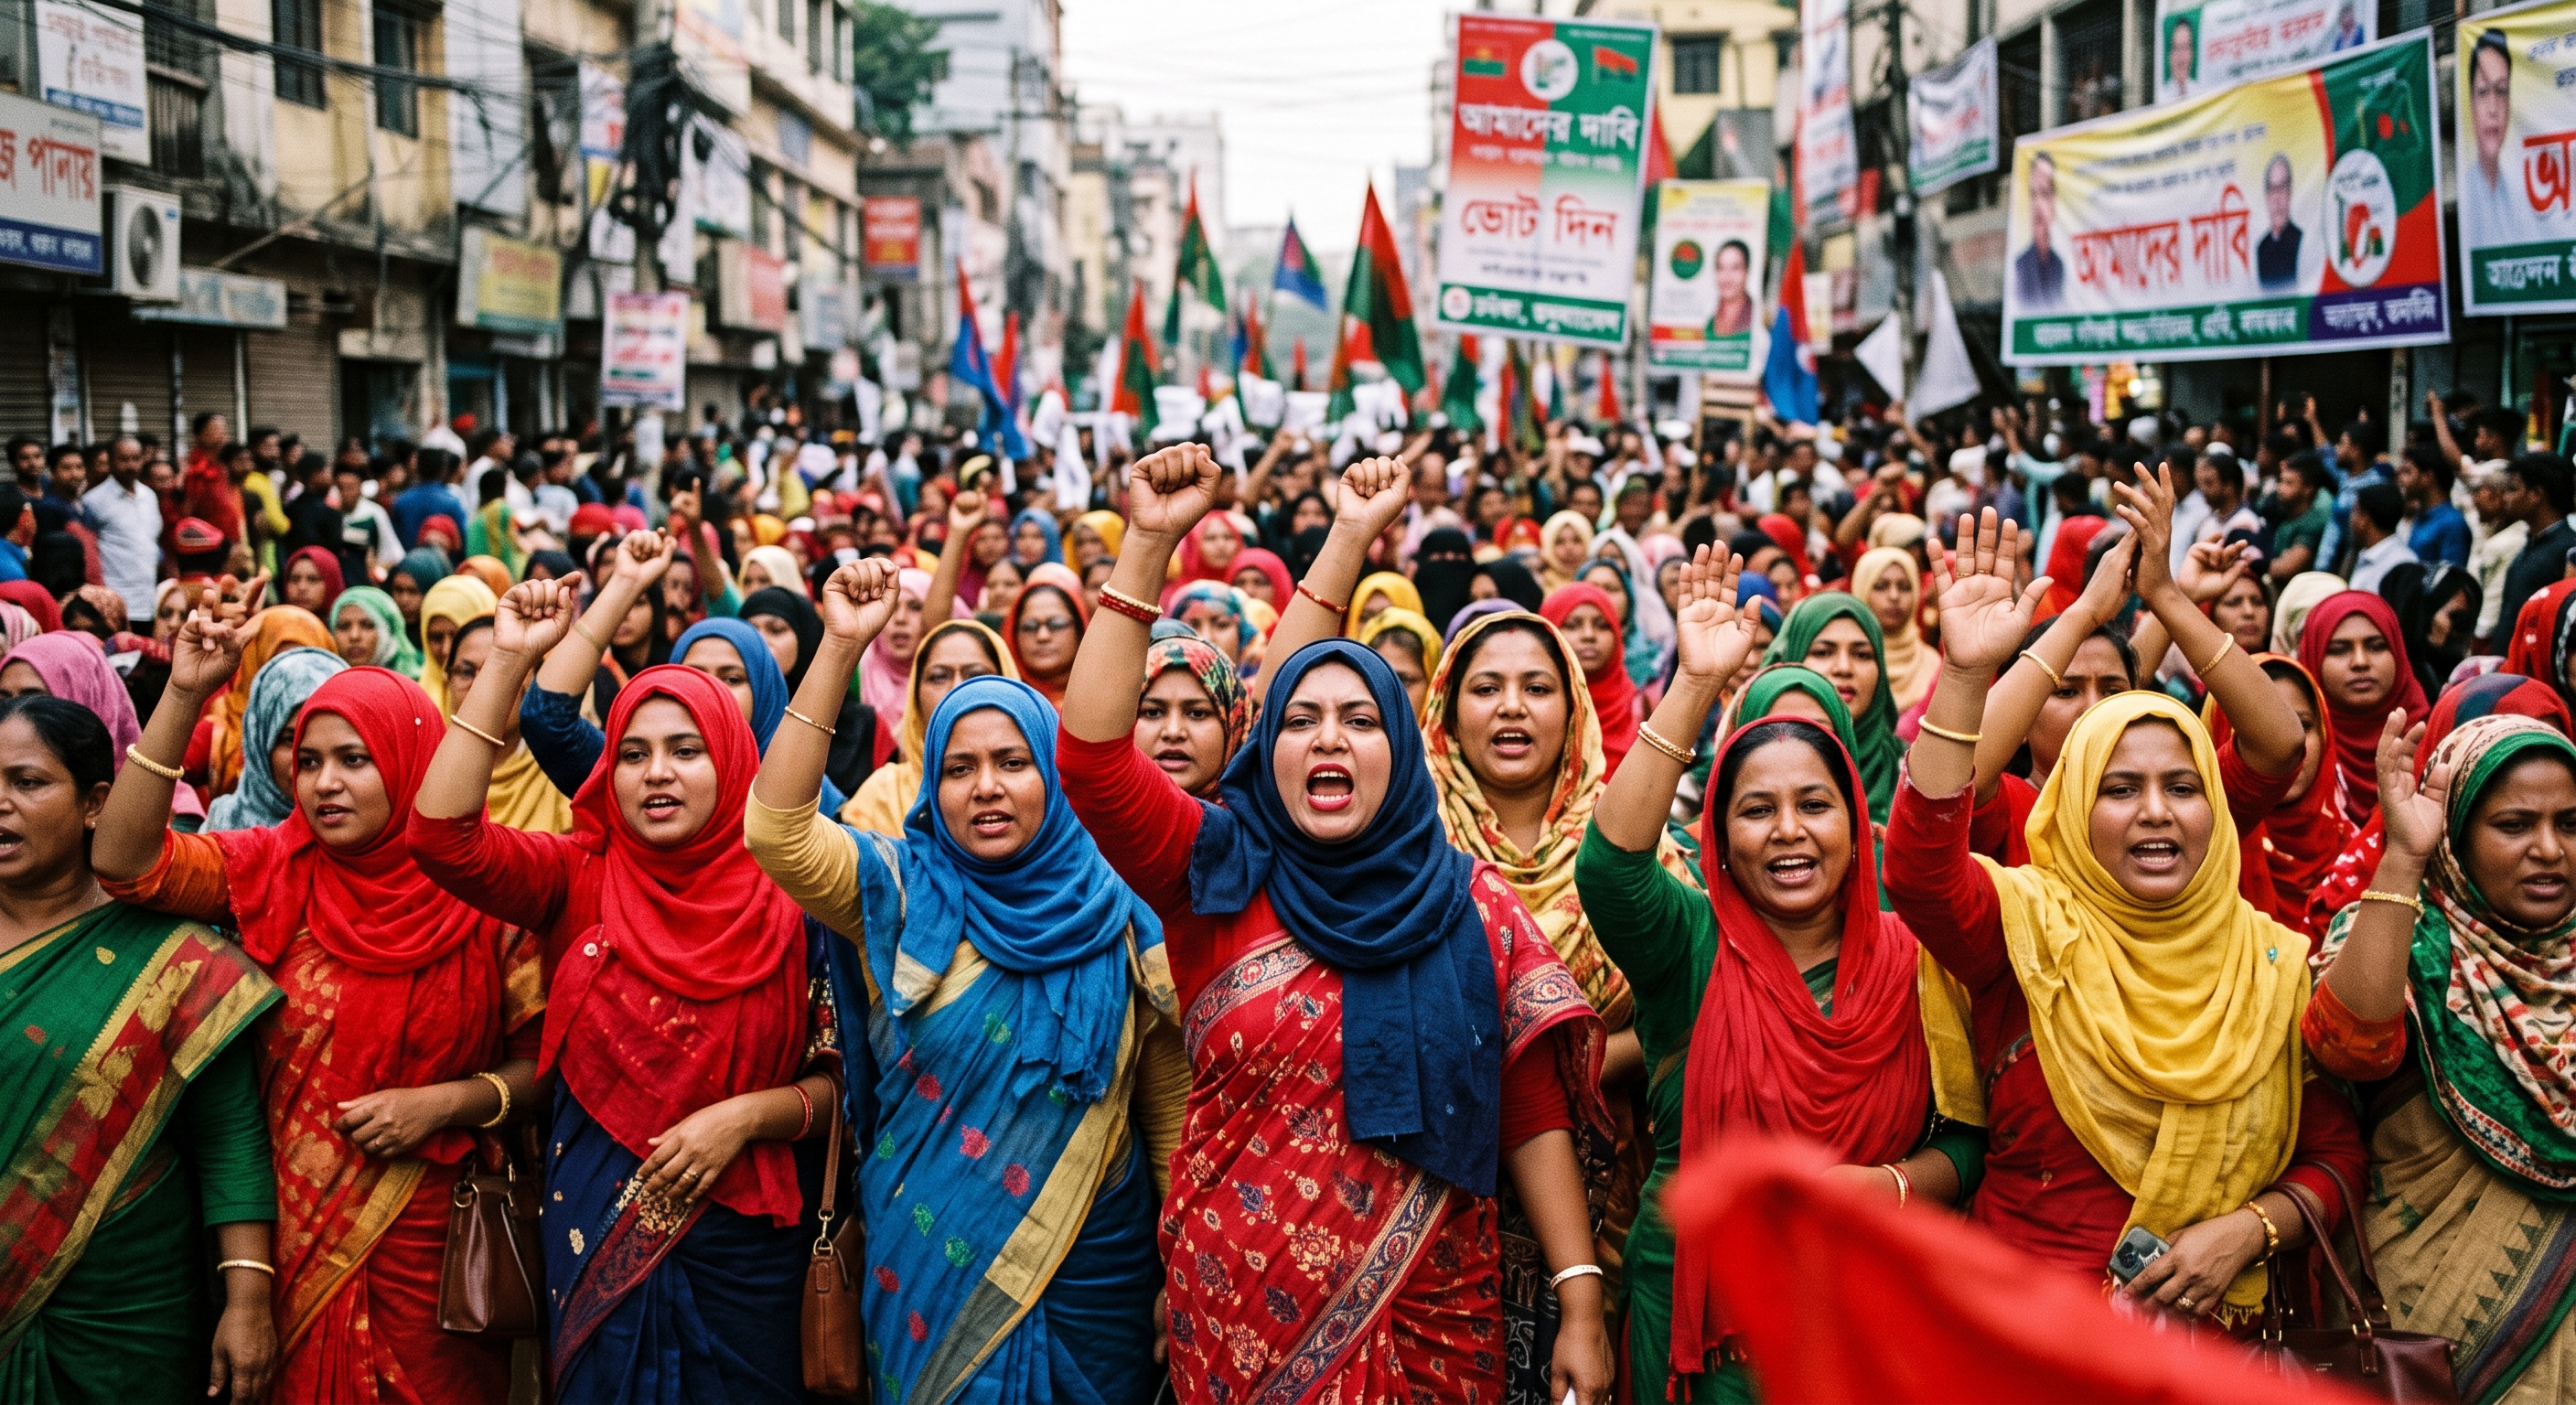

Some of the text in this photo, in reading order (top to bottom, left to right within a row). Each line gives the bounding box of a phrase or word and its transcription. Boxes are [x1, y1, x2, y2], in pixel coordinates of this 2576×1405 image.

[1457, 102, 1640, 151] আমাদের দাবি
[1461, 191, 1618, 250] ভোট দিন
[2071, 182, 2251, 292] আমাদের দাবি
